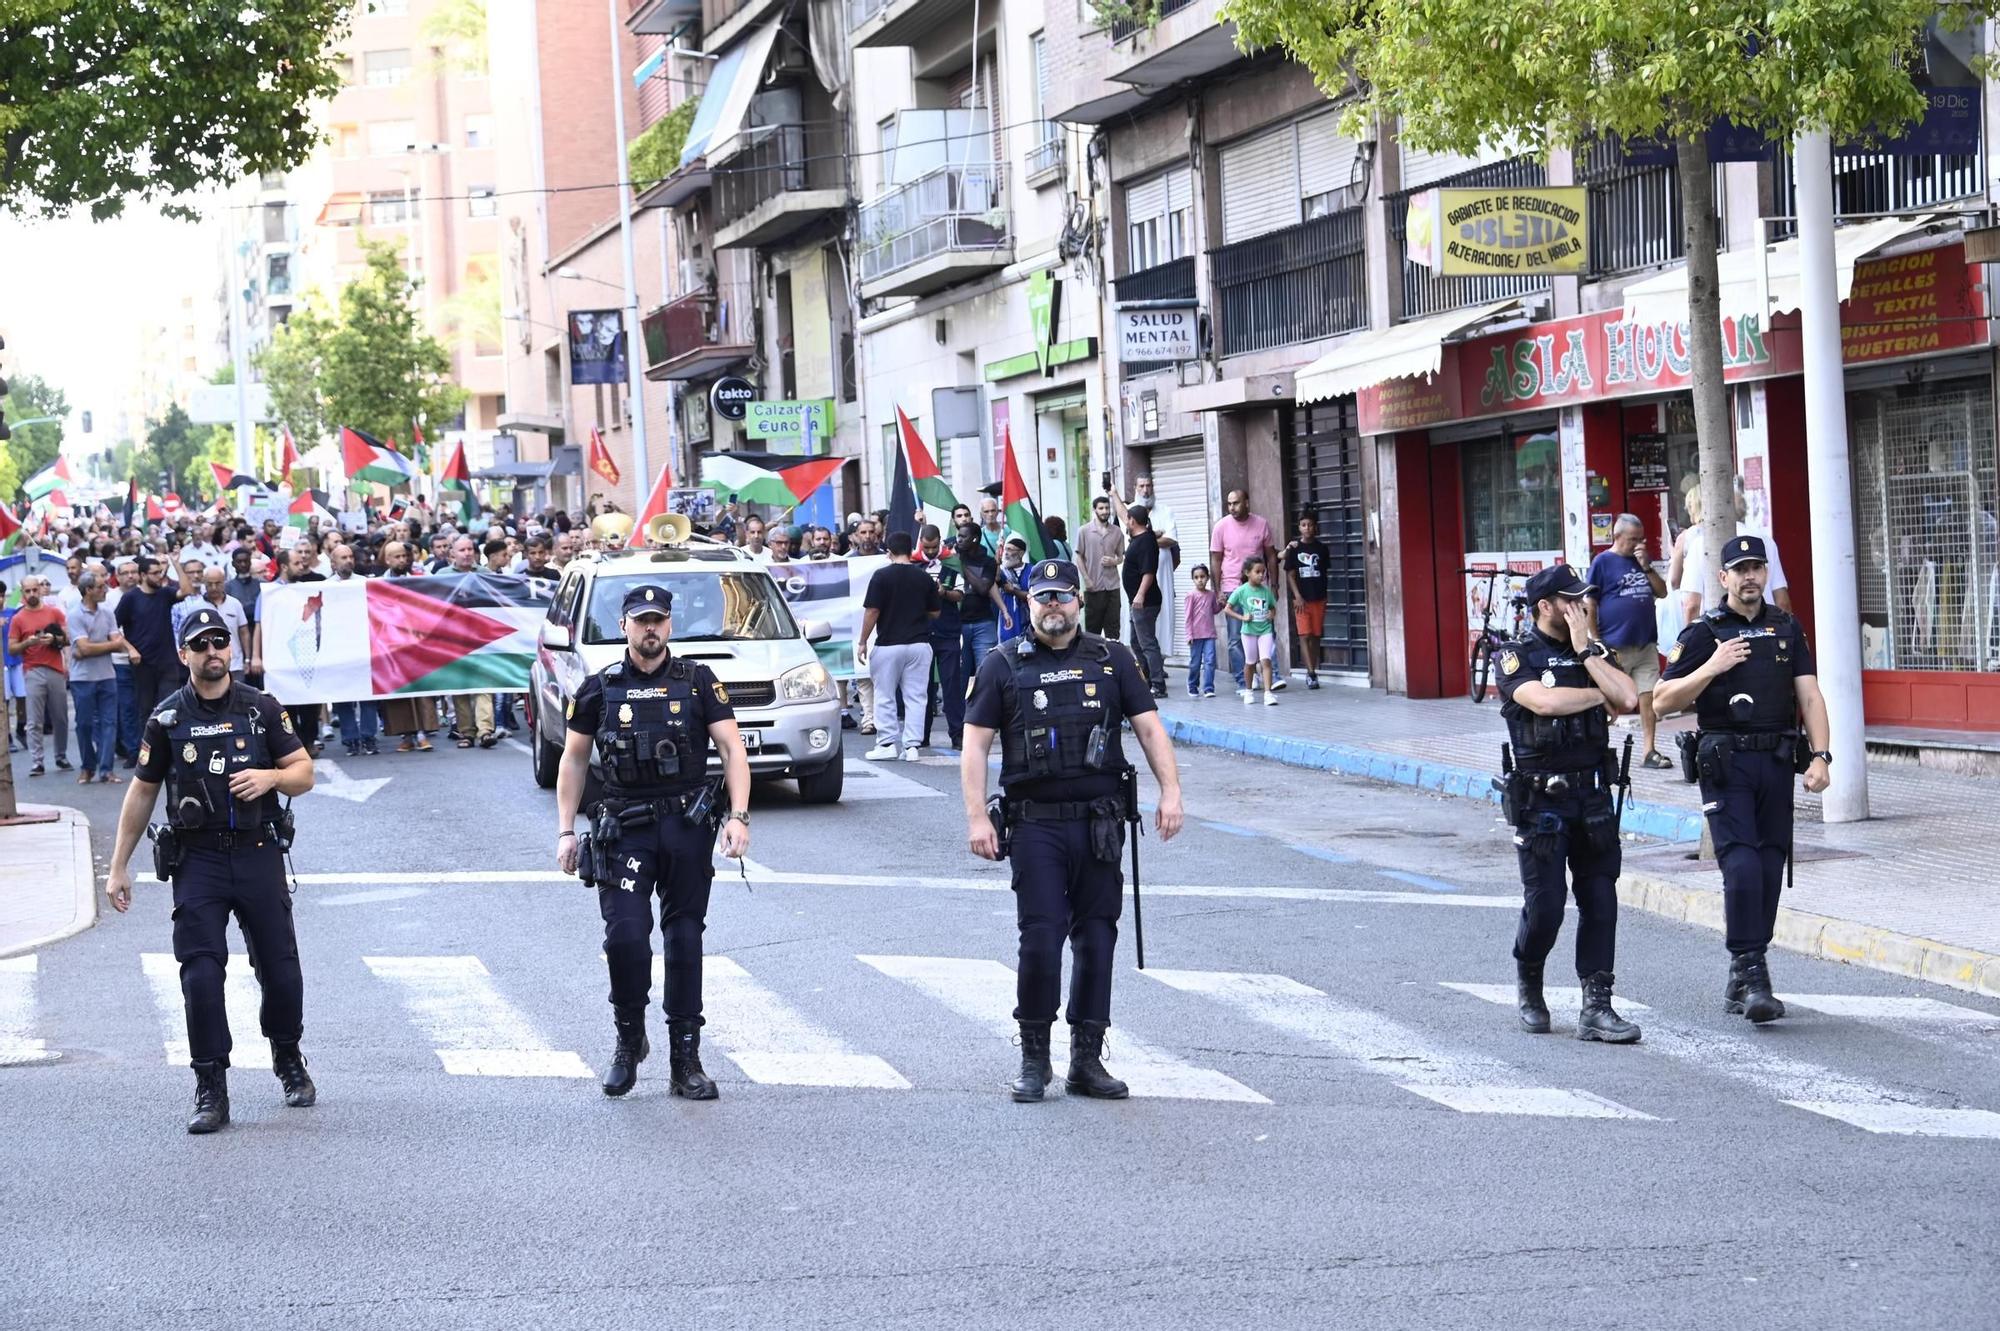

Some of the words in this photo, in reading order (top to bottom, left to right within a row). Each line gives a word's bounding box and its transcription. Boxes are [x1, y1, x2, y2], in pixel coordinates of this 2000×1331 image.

[1933, 95, 1945, 108] 19
[1948, 95, 1969, 108] Dic
[1447, 199, 1493, 226] GABINETE
[1496, 196, 1509, 211] DE
[1513, 196, 1580, 226] REEDUCACION
[1460, 214, 1568, 249] DISLEXIA
[1447, 241, 1521, 268] ALTERACIONES
[1526, 251, 1547, 267] DEL
[1548, 237, 1581, 262] HABLA
[1855, 252, 1935, 278] INACION
[1850, 272, 1937, 298] DETALLES
[1873, 293, 1937, 315] TEXTIL
[1130, 313, 1183, 327] SALUD
[1126, 330, 1190, 344] MENTAL
[1842, 332, 1939, 358] GUETERIA
[1135, 347, 1153, 356] 966
[1481, 329, 1593, 405] ASIA
[719, 388, 752, 400] takto
[1041, 675, 1082, 684] NACIONAL
[191, 728, 233, 737] NACIONAL
